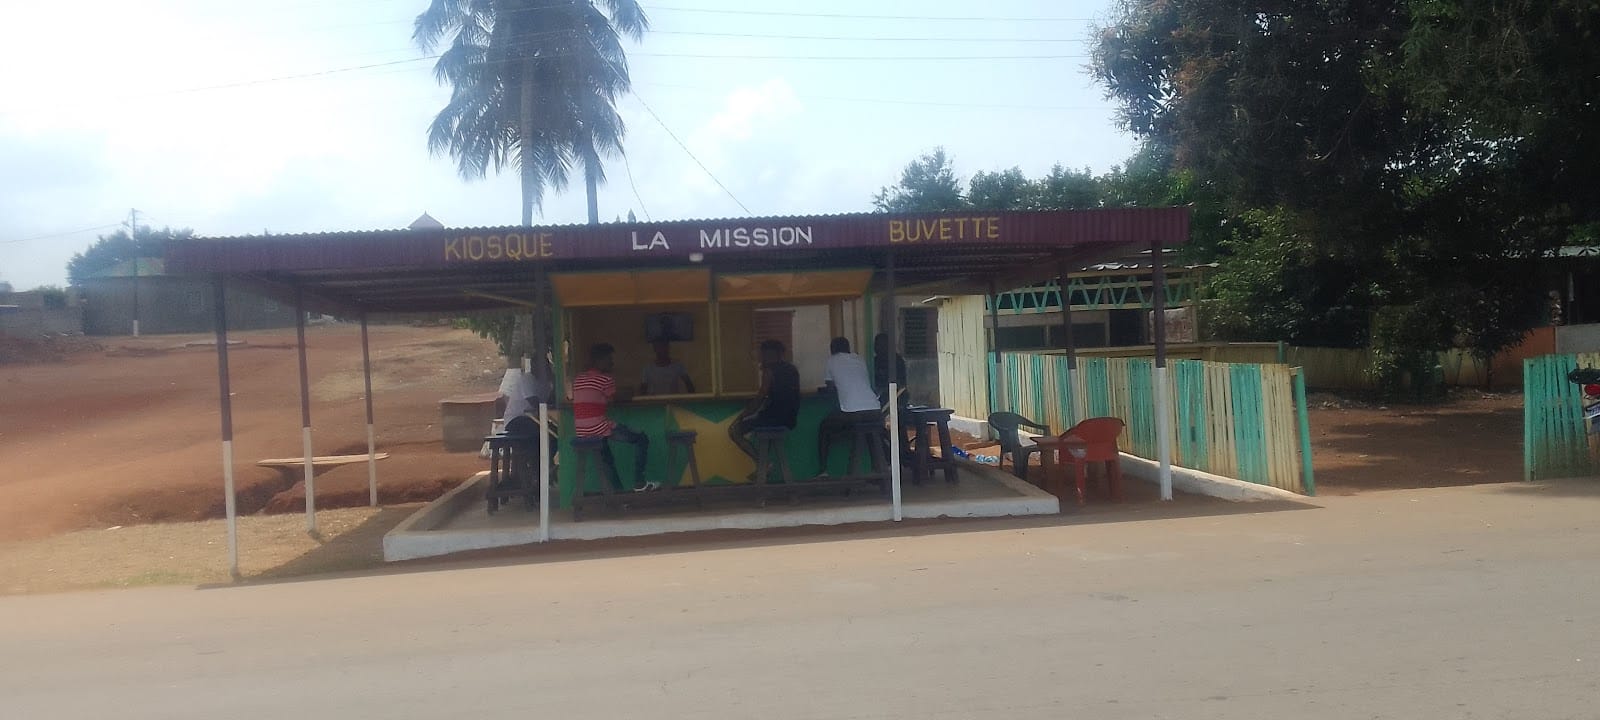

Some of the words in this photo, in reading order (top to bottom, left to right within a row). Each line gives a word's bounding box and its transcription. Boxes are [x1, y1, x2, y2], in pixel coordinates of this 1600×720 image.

[444, 233, 553, 261] KIOSQUE
[631, 231, 670, 251] LA
[699, 226, 813, 249] MISSION
[889, 217, 1000, 243] BUVETTE
